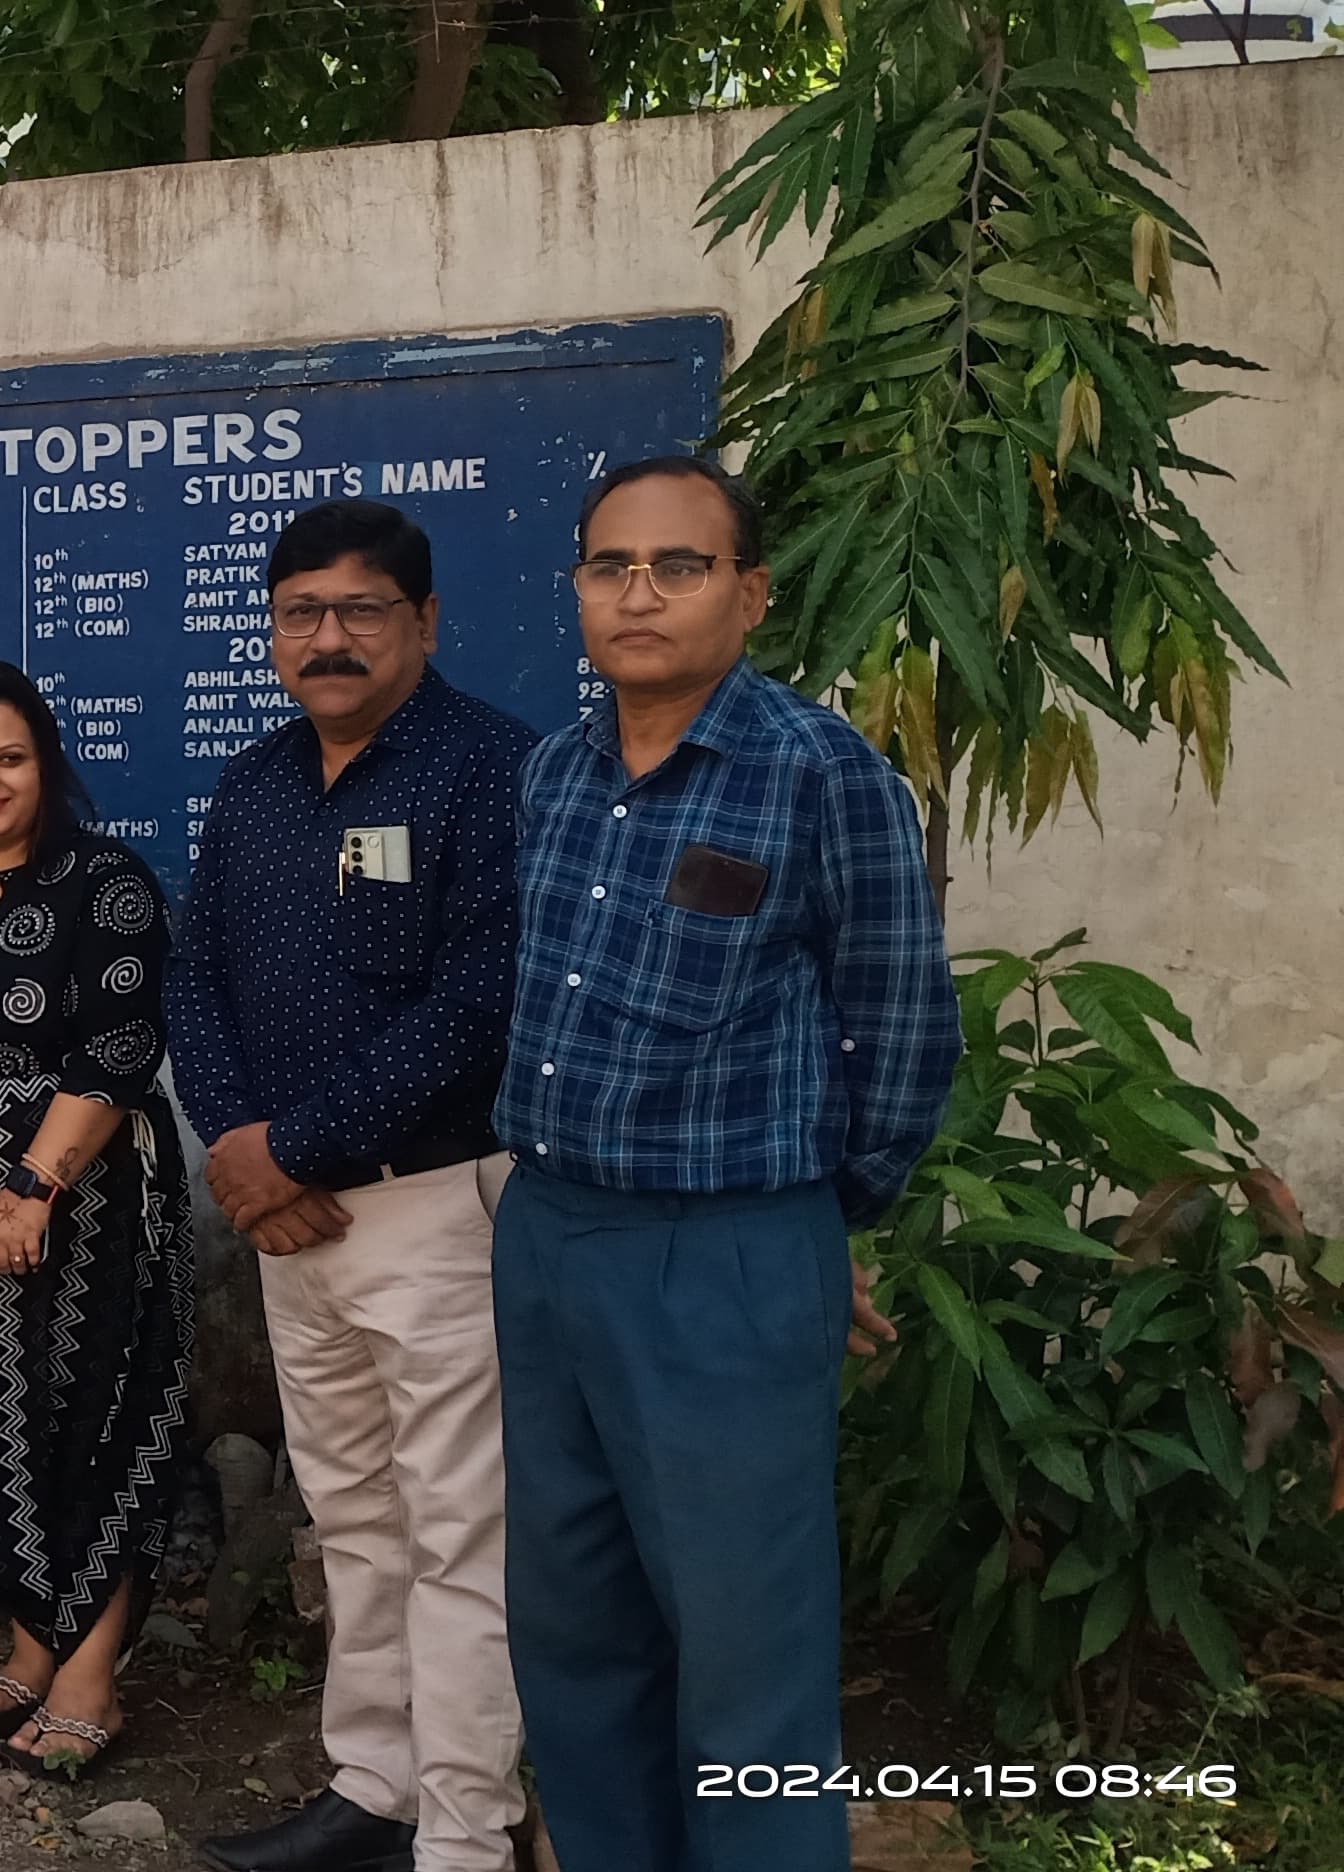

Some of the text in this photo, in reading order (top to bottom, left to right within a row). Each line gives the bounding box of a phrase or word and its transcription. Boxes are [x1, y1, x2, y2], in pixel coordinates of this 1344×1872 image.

[33, 450, 606, 513] CLASS STUDENT'S NAME %
[228, 509, 295, 535] 2011
[33, 542, 267, 570] 10th SATYAM
[33, 565, 261, 593] 12th (MATHS) PRATIK
[34, 595, 68, 615] 12th
[76, 594, 124, 615] (BIO)
[184, 590, 238, 609] AMIT
[35, 618, 68, 639] 12th
[74, 617, 130, 638] (COM)
[228, 637, 273, 663] 20
[36, 672, 66, 693] 10th
[70, 695, 143, 716] (MATHS)
[184, 694, 238, 711] AMIT
[248, 692, 301, 709] WAL
[77, 719, 121, 738] (BIO)
[183, 717, 254, 734] ANJALI
[77, 740, 129, 762] (COM)
